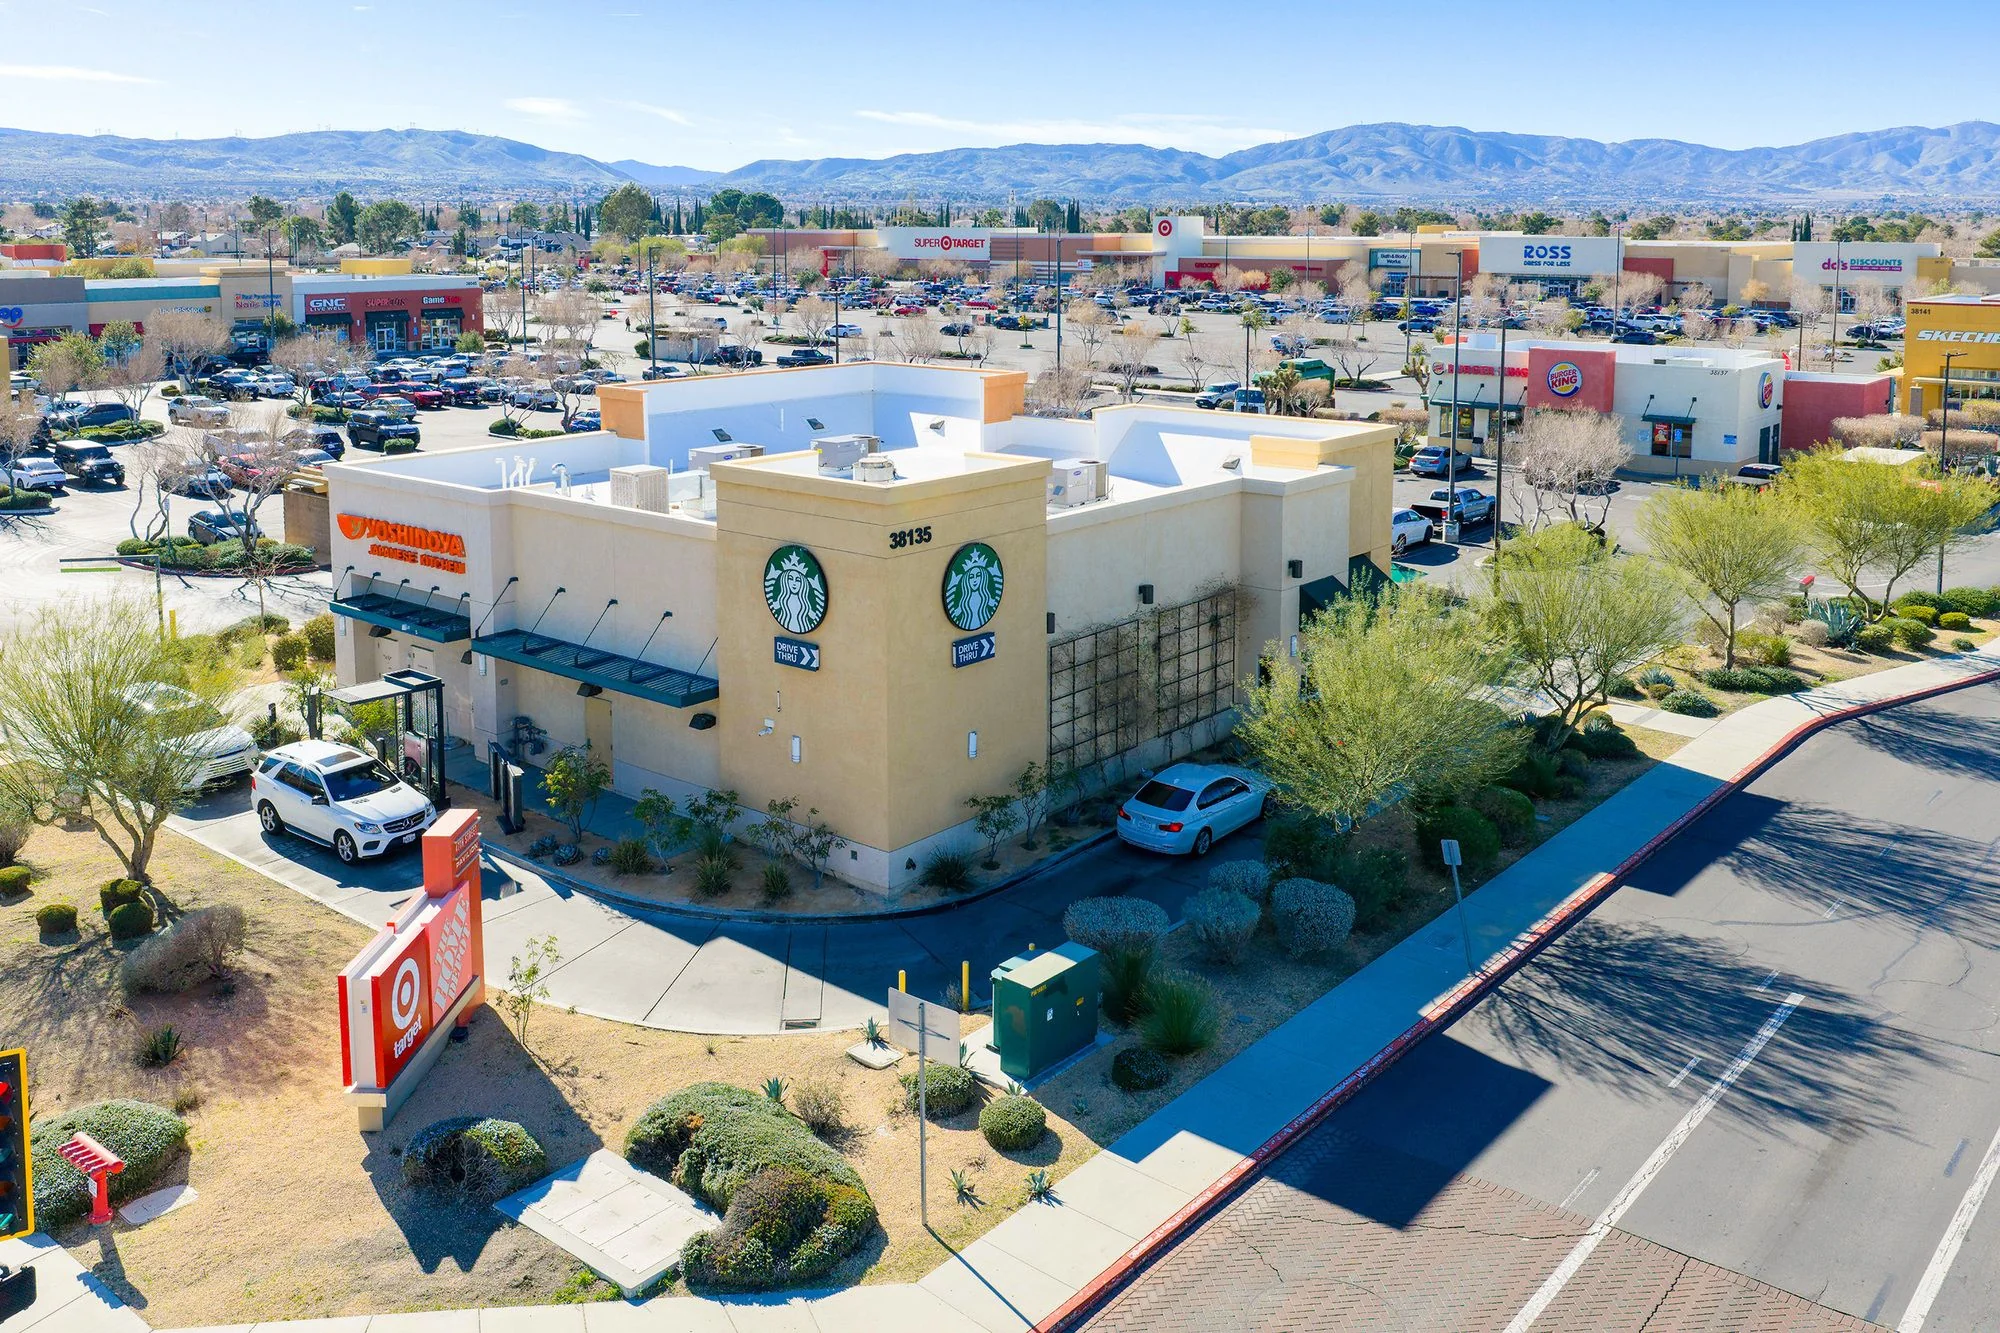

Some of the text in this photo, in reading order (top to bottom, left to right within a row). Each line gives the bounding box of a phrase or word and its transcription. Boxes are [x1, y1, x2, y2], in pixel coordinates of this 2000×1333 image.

[914, 238, 986, 247] SUPER TARGET
[1523, 245, 1571, 259] ROSS
[1850, 258, 1903, 266] DISCOUNTS
[309, 298, 346, 307] GNC
[1551, 369, 1577, 380] BURGER
[1551, 375, 1578, 388] KING
[889, 526, 932, 549] 38135
[368, 543, 466, 575] JAPANESE KITCHEN
[776, 641, 799, 655] DRIVE
[958, 641, 979, 654] DRIVE
[776, 650, 797, 663] THRU
[958, 650, 978, 663] THRU
[434, 917, 451, 966] THE
[434, 892, 470, 1012] HOME
[447, 922, 470, 1001] DEPOT
[394, 1013, 422, 1058] target
